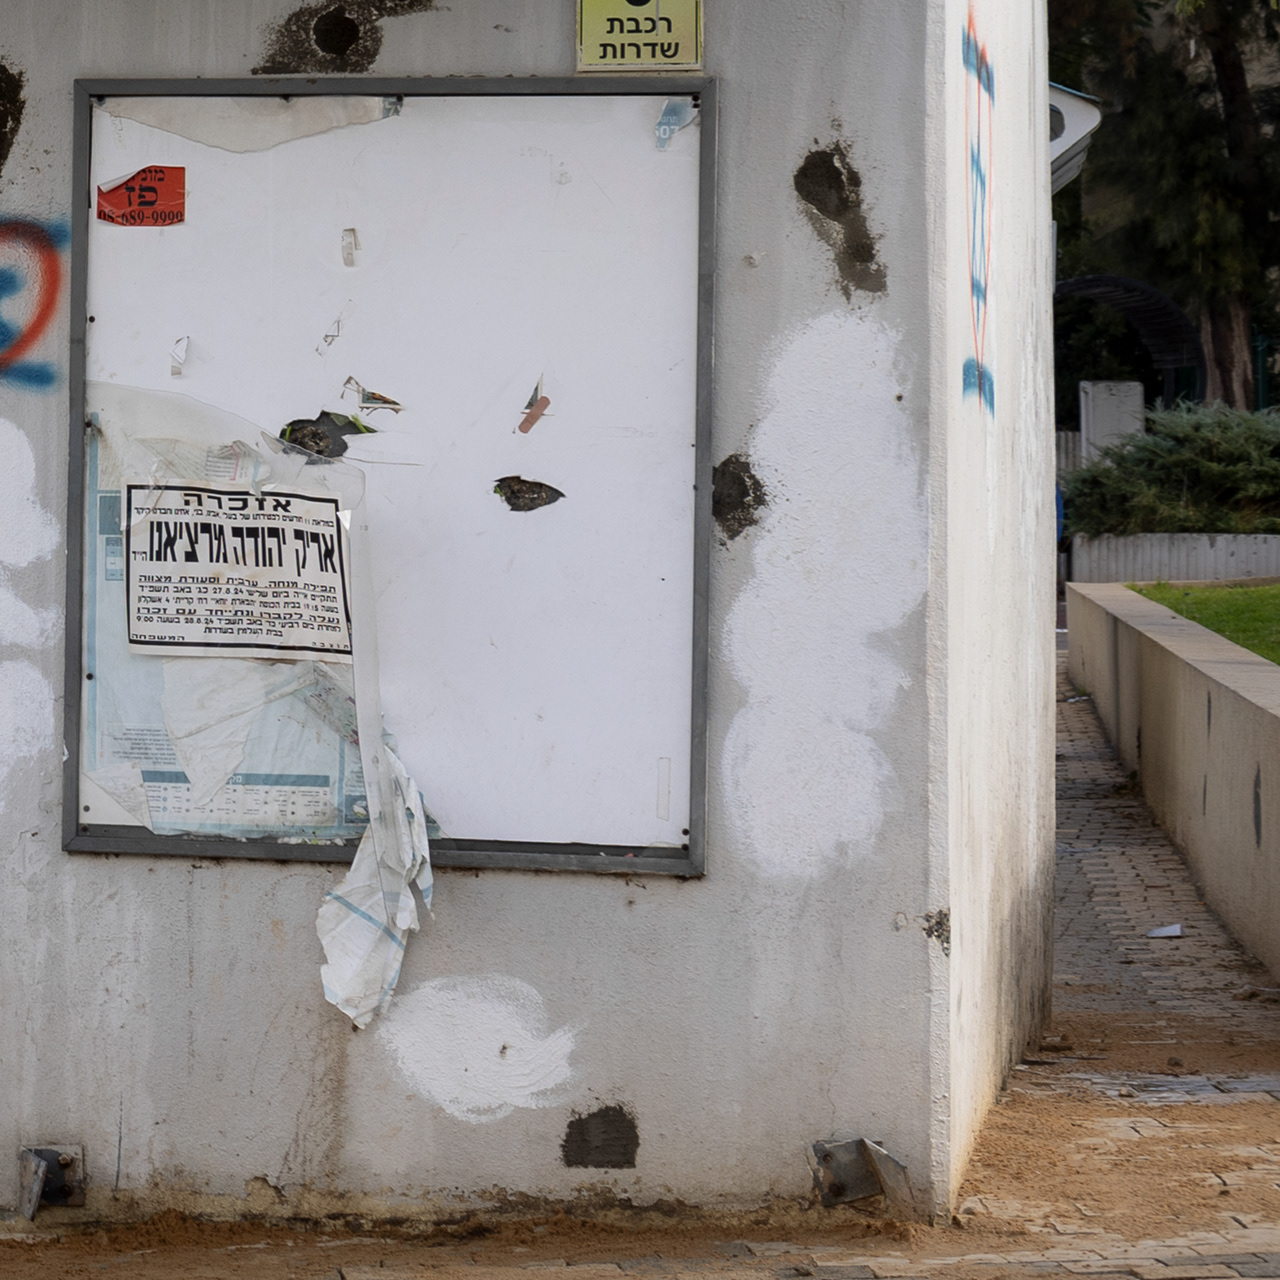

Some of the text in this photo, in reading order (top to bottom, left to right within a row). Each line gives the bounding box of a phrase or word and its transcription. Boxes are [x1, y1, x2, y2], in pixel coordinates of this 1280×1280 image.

[606, 17, 672, 34] רכבת
[599, 42, 679, 59] שדרות
[125, 184, 158, 207] פז
[183, 493, 291, 513] אזכרה
[239, 513, 251, 521] של
[149, 521, 228, 563] מרציאנו
[231, 527, 287, 567] יהודה
[293, 528, 338, 577] אריק
[138, 575, 172, 583] מצווה
[178, 576, 220, 584] וסעודת
[226, 577, 258, 587] ערבית
[173, 586, 192, 594] באב
[303, 582, 336, 593] תפילת
[272, 590, 289, 598] ביום
[205, 608, 253, 616] ונתייחד
[260, 612, 303, 620] לקברו
[308, 615, 340, 624] נעלה
